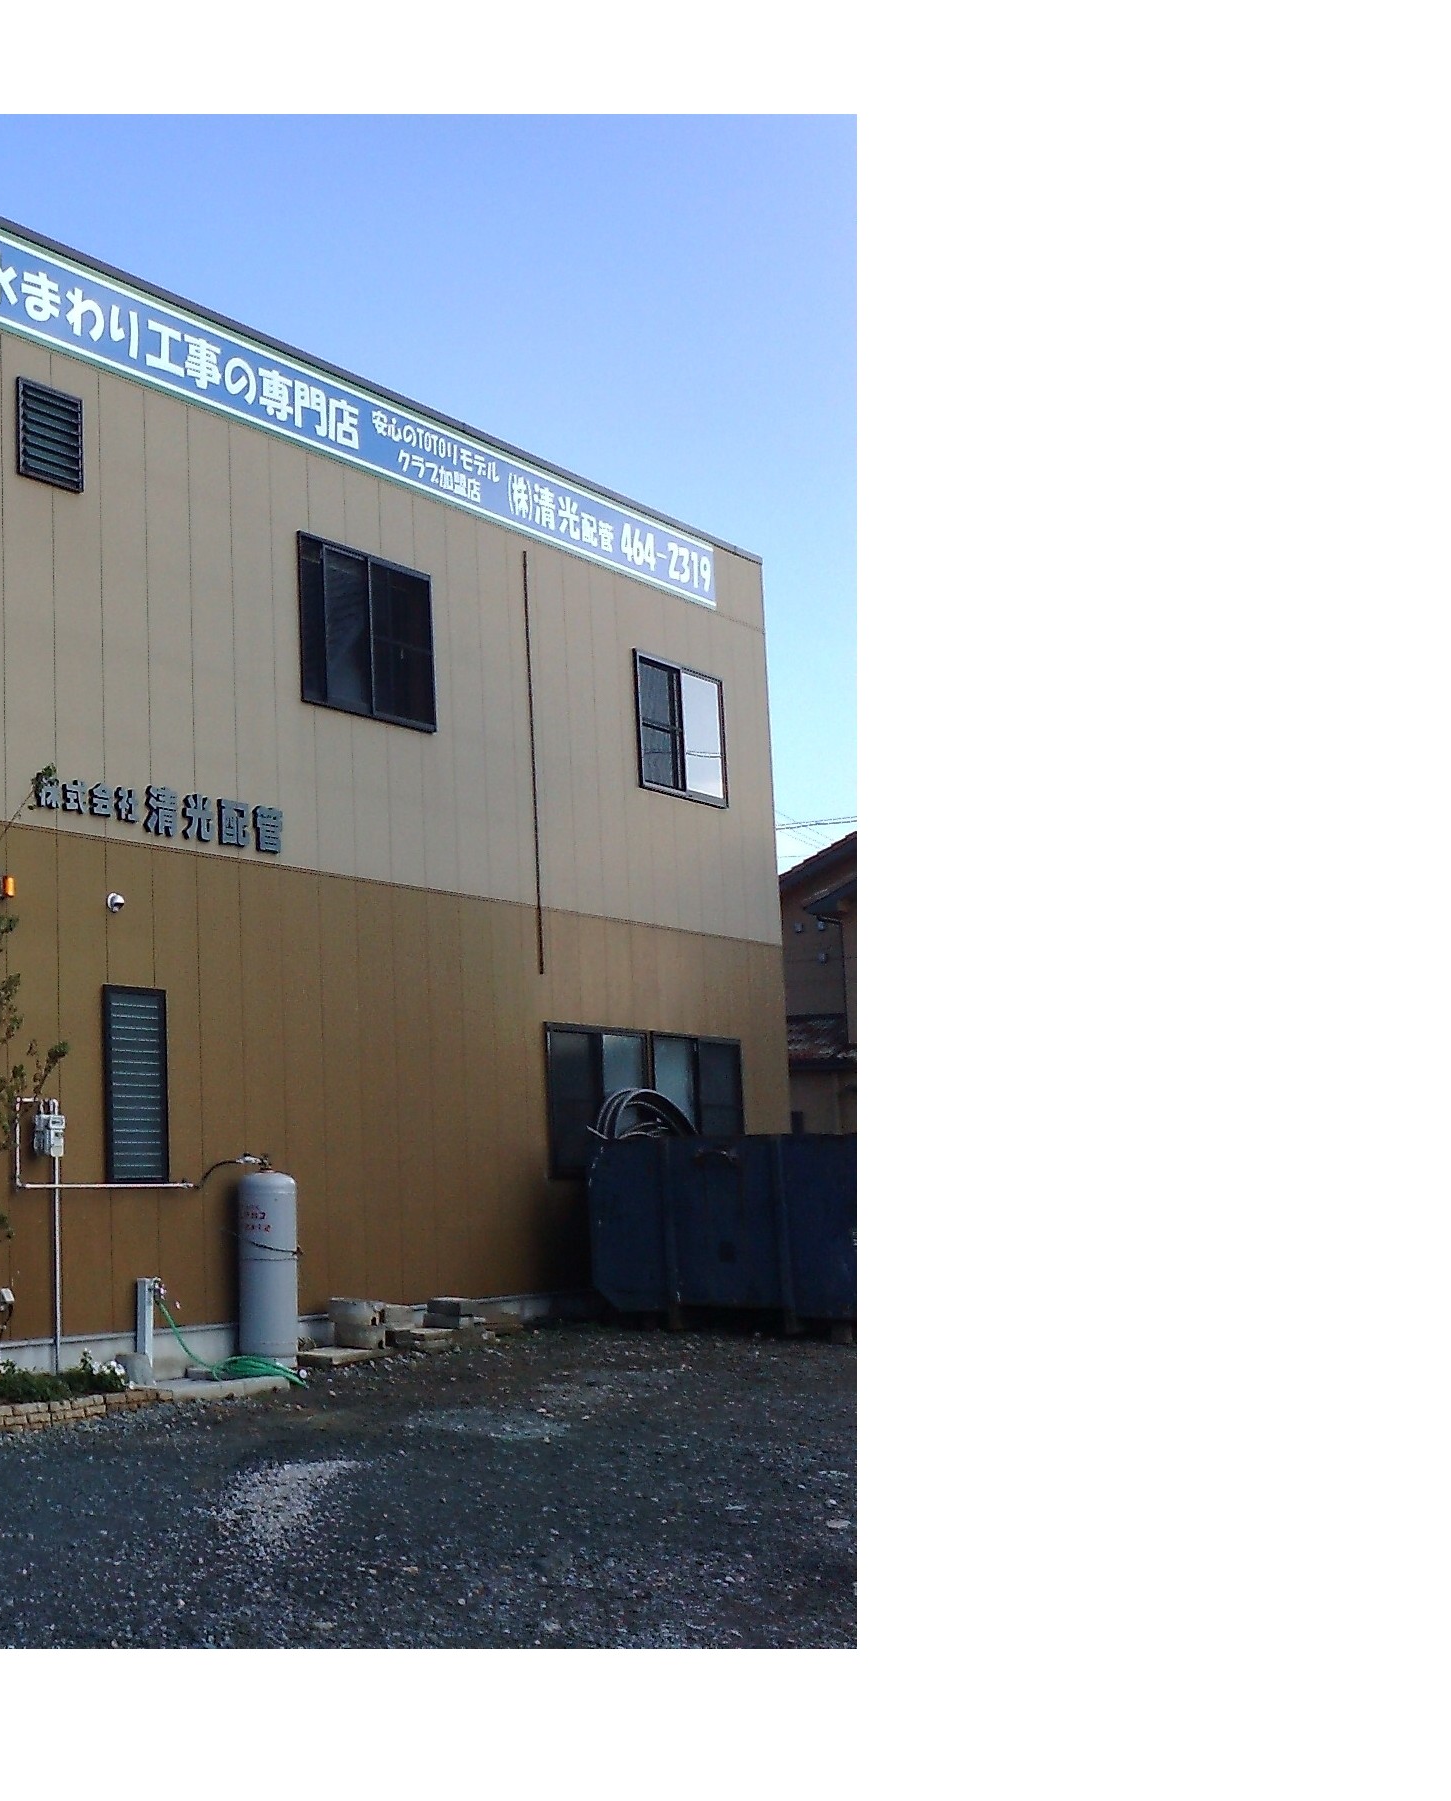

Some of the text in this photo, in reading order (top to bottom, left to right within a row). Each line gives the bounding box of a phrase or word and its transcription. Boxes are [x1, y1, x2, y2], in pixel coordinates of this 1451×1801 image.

[397, 448, 481, 503] クラブ加盟店
[620, 522, 712, 593] 464-2319
